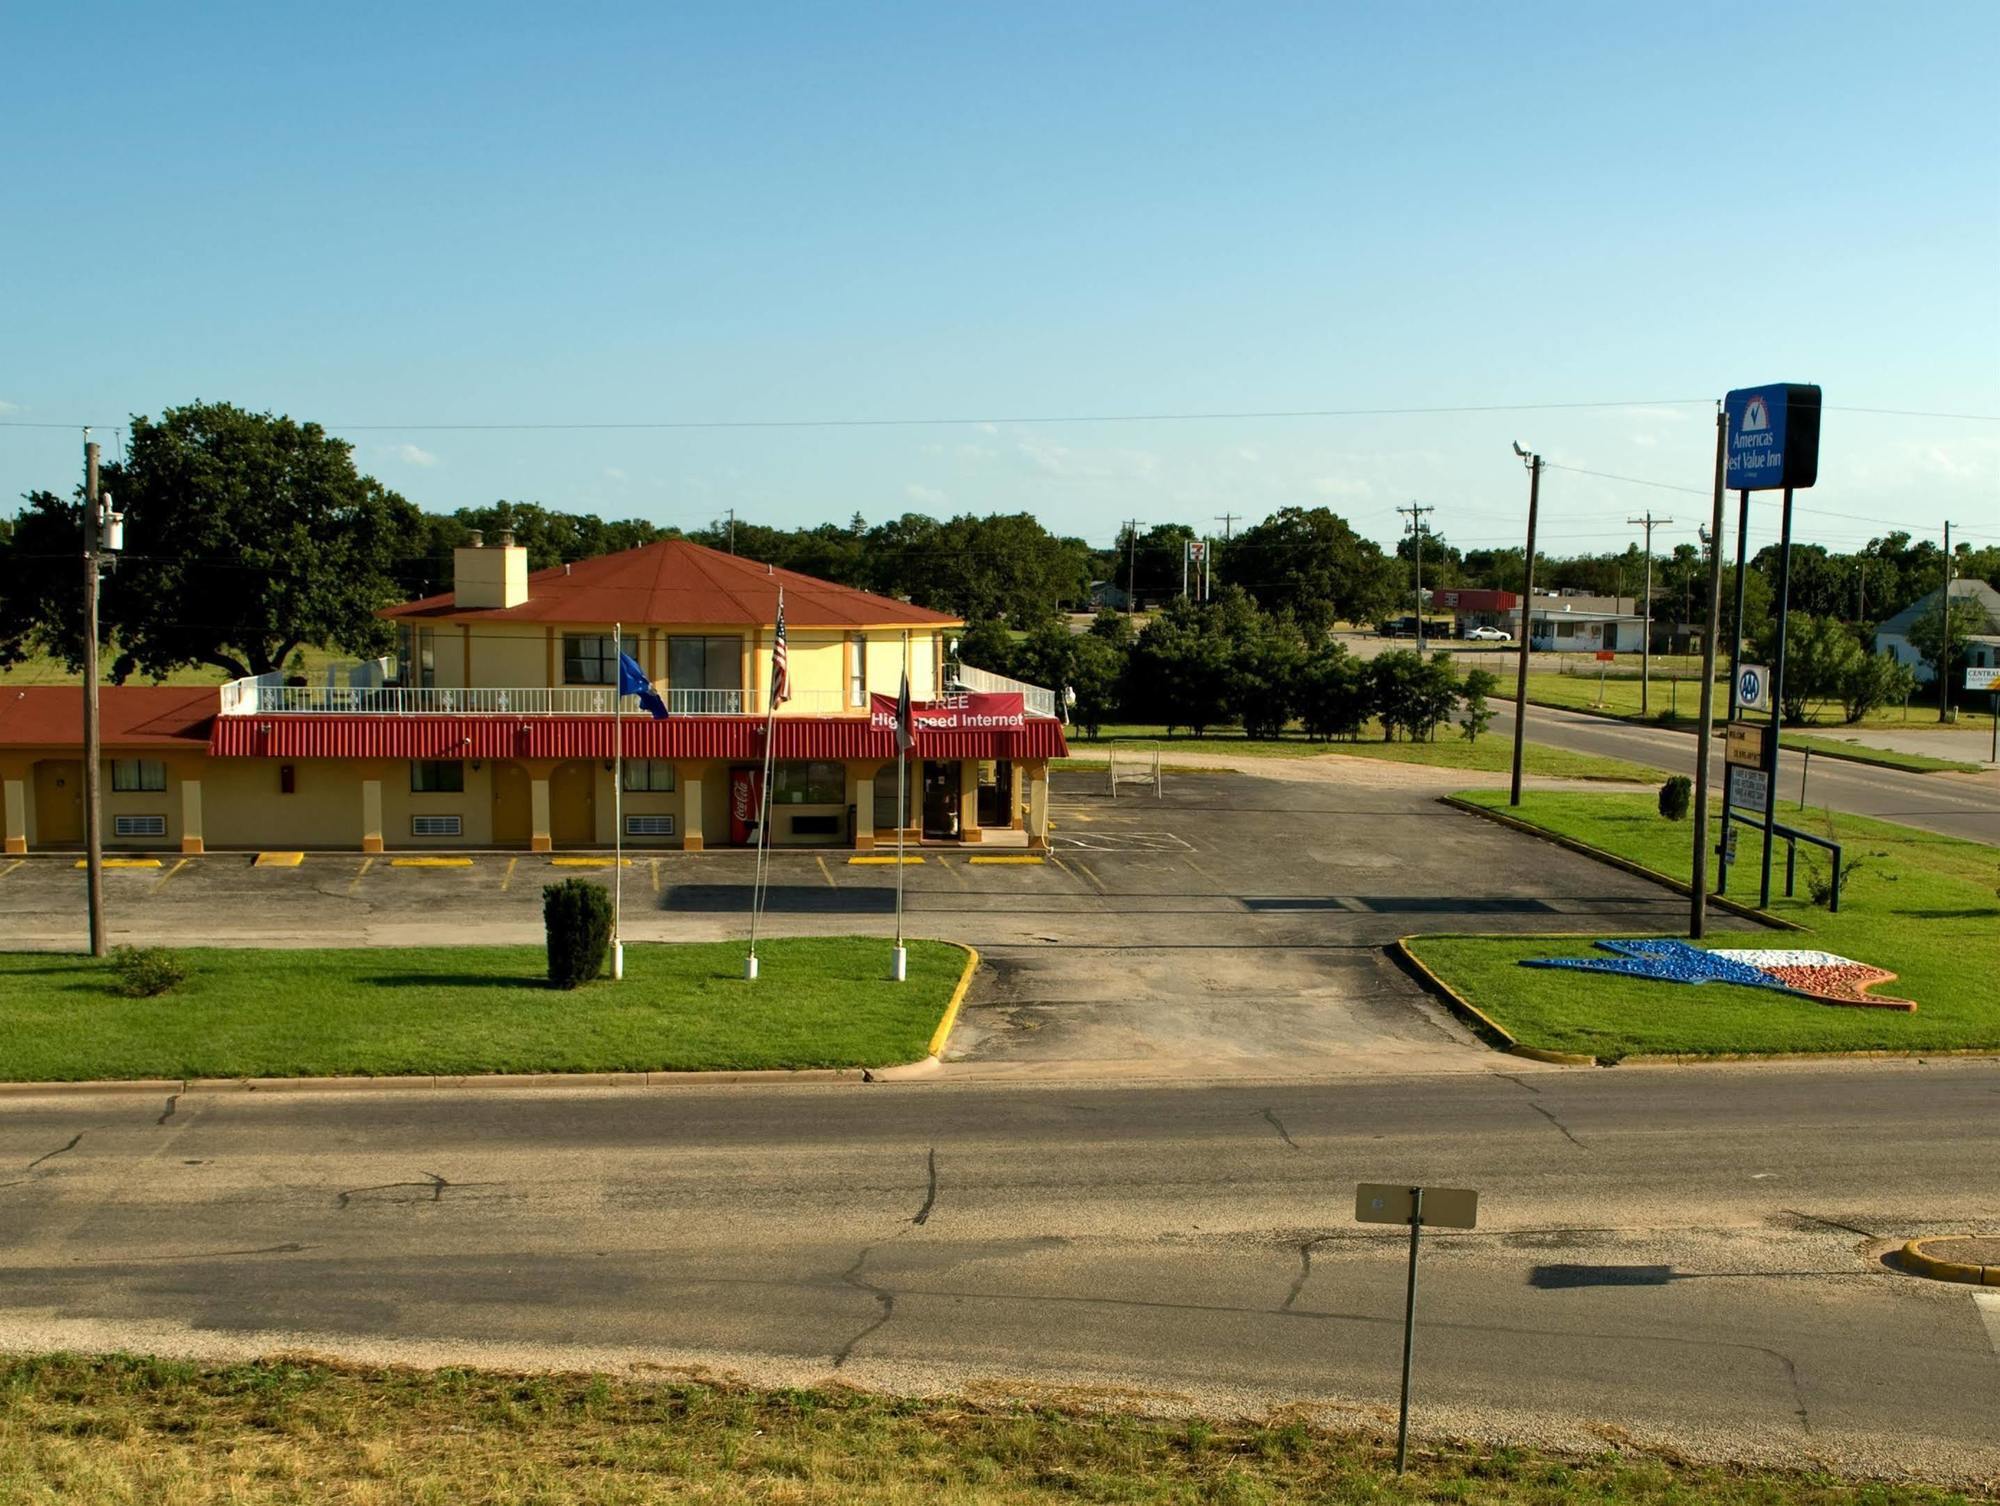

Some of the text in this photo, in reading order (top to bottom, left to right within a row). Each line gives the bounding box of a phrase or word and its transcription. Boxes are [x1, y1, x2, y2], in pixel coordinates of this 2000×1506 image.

[1733, 432, 1773, 449] Americas
[1727, 449, 1782, 471] est Value Inn
[925, 695, 969, 710] FREE
[871, 712, 898, 729] Hig
[962, 712, 1024, 727] Internet
